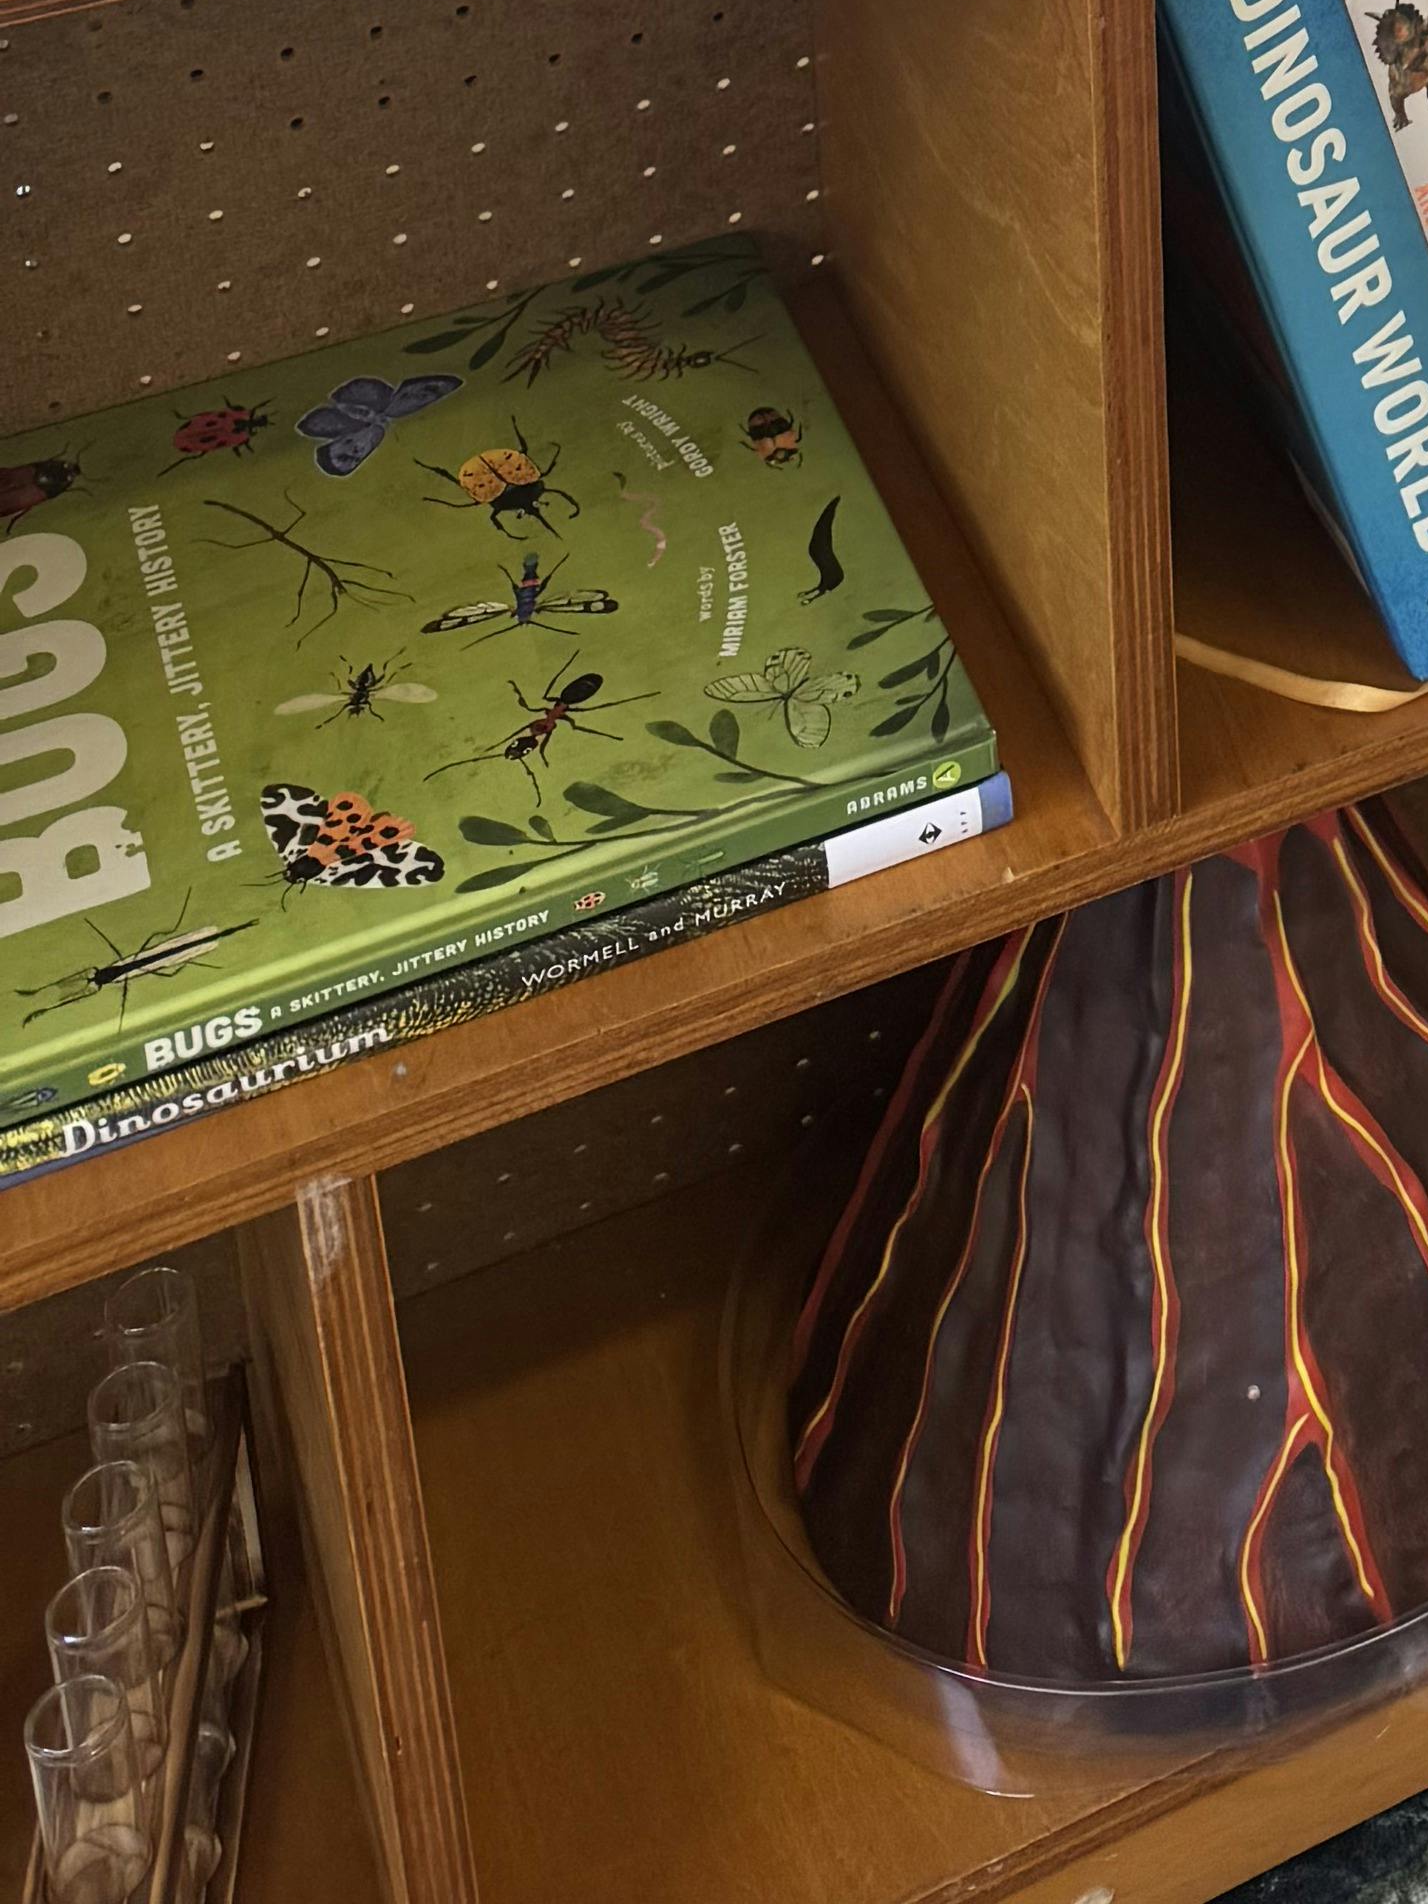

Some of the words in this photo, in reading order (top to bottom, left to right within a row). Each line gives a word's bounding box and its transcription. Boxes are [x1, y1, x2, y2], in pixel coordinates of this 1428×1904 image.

[621, 393, 681, 438] WRIGHT
[630, 429, 675, 471] pictures
[671, 435, 715, 478] GORDY
[128, 503, 179, 597] HISTORY
[697, 565, 715, 583] by
[718, 521, 750, 592] FORSTER
[697, 584, 714, 623] words
[719, 593, 748, 657] MIRIAM
[150, 601, 204, 696] JITTERY
[175, 701, 239, 838] SKITTERY,
[846, 776, 929, 816] ABRAMS
[207, 838, 243, 863] A
[521, 938, 640, 989] WORMELL
[648, 917, 686, 943] and
[695, 882, 788, 928] MURRAY
[143, 1004, 264, 1072] BUGS
[270, 1004, 284, 1020] A
[392, 939, 468, 978] JITTERY
[475, 909, 551, 949] HISTORY
[59, 1024, 392, 1159] Dinosaurium
